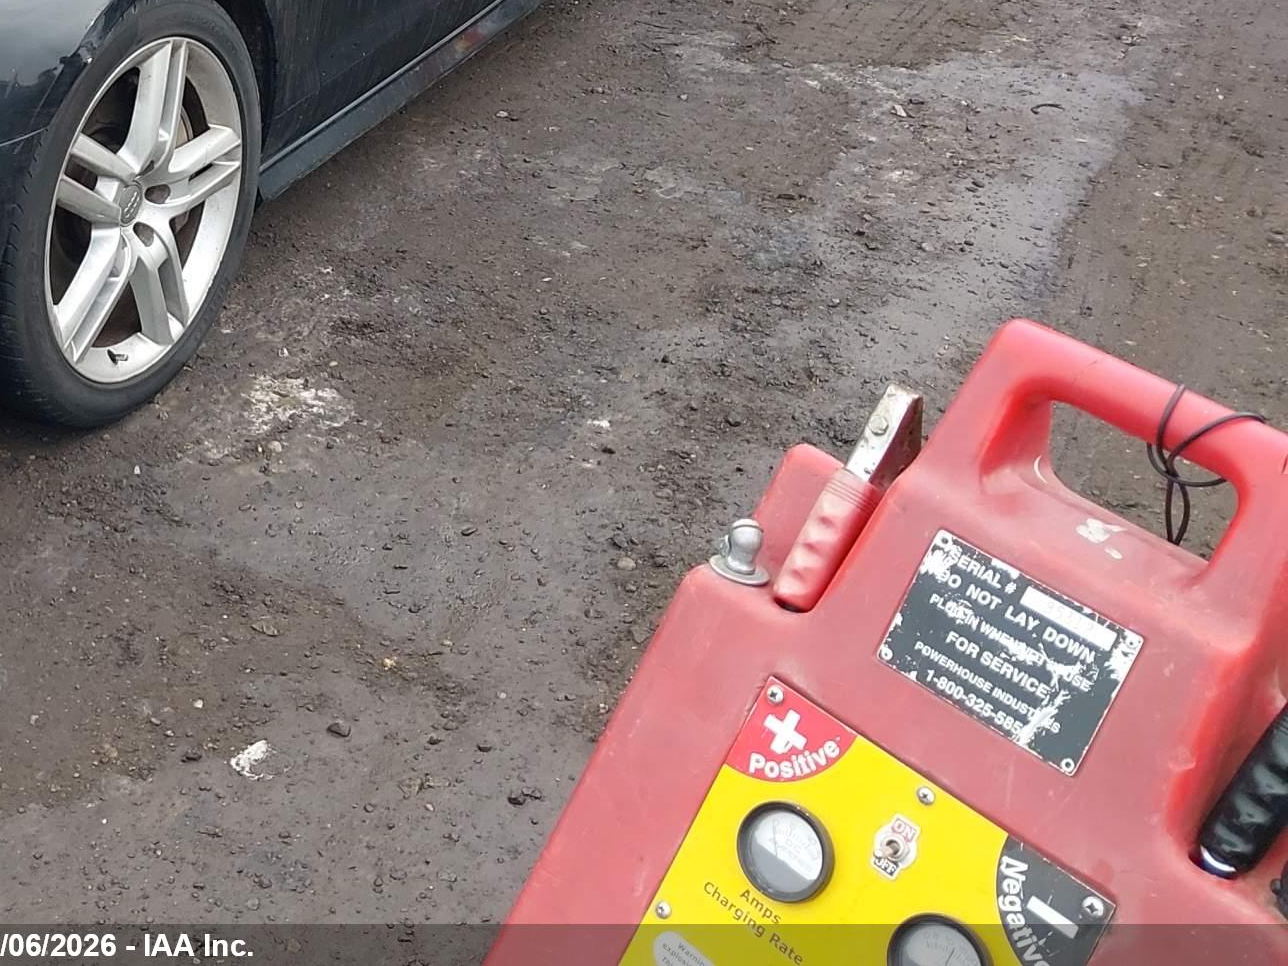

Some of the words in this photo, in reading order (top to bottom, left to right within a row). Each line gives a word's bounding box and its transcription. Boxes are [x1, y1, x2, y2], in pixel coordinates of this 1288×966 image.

[950, 547, 1001, 589] SERIAL
[965, 585, 1002, 610] NOT
[1004, 605, 1040, 632] LAY
[1043, 626, 1096, 664] DOWN
[914, 640, 992, 693] POWERHOUSE
[991, 684, 1061, 734] INDUSTS
[945, 631, 980, 658] FOR
[980, 650, 1050, 700] SERVICE
[1062, 669, 1093, 692] USE
[925, 669, 1028, 737] 1-800-325-585
[748, 740, 841, 779] Positive
[891, 819, 917, 842] ON
[702, 881, 765, 938] Charging
[768, 934, 804, 966] Rate
[739, 889, 782, 925] Amps
